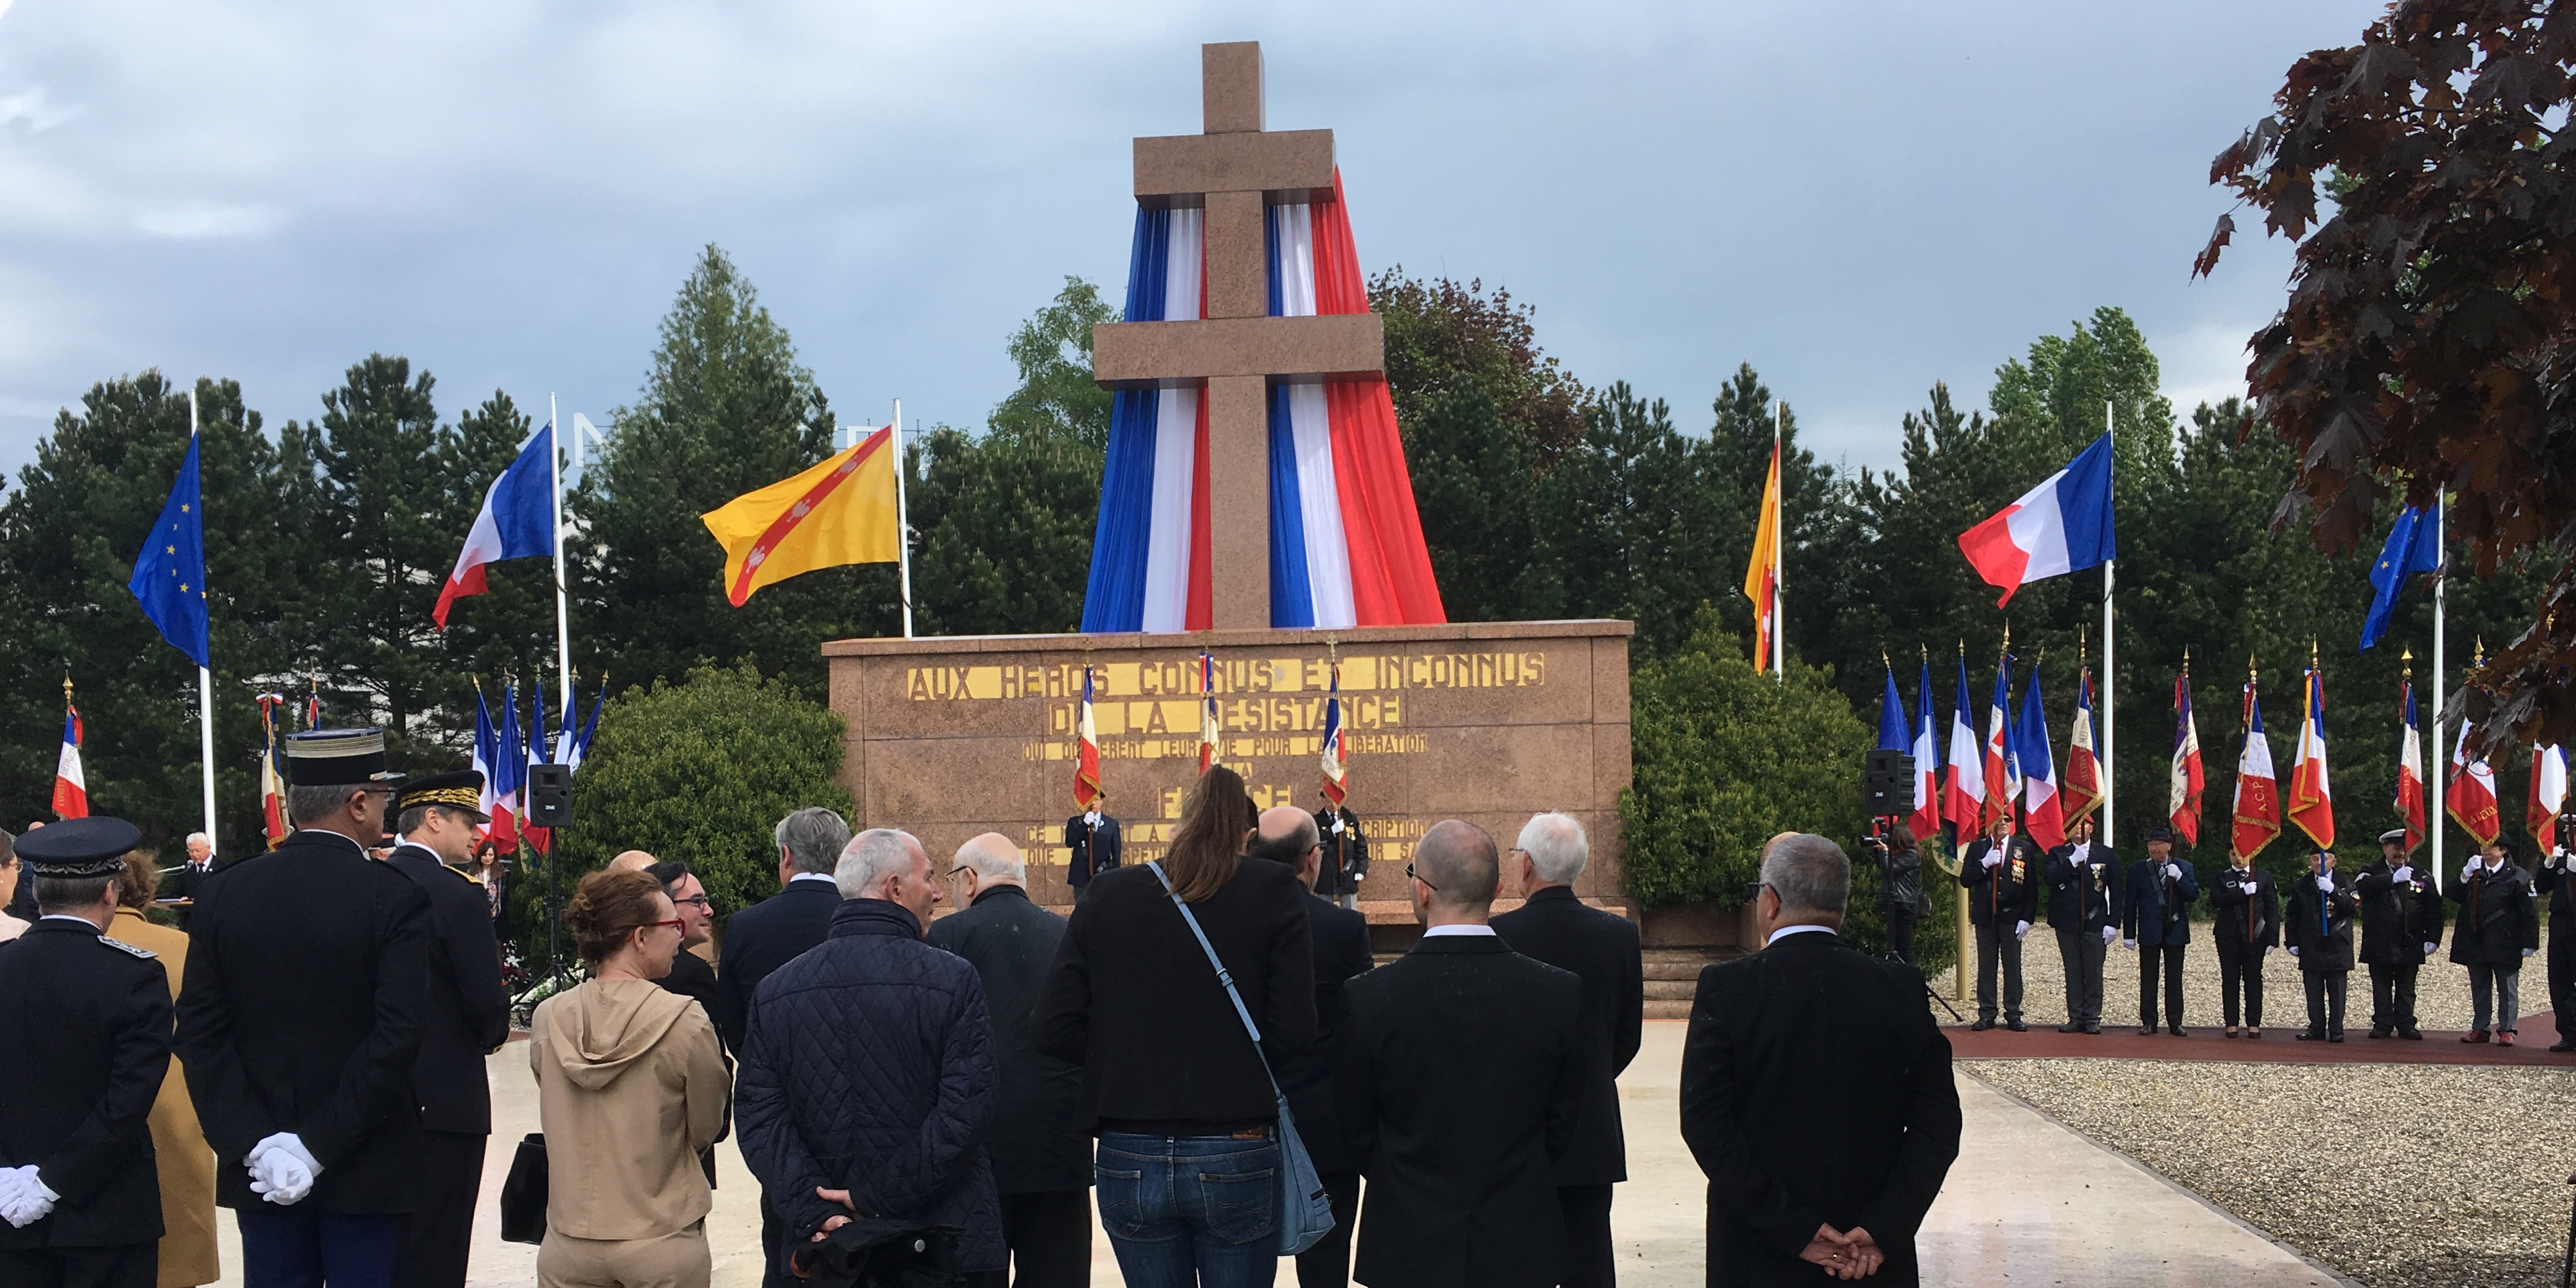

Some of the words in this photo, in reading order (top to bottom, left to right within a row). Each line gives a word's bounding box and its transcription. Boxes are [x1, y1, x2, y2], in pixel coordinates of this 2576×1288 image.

[911, 667, 974, 700] AUX
[1001, 665, 1109, 698] HEROS
[1375, 651, 1544, 689] INCONNUS
[1125, 701, 1169, 735] LA
[1199, 691, 1399, 733] ESISTANCE
[1161, 739, 1197, 758] LEUR
[1253, 737, 1290, 756] POUR
